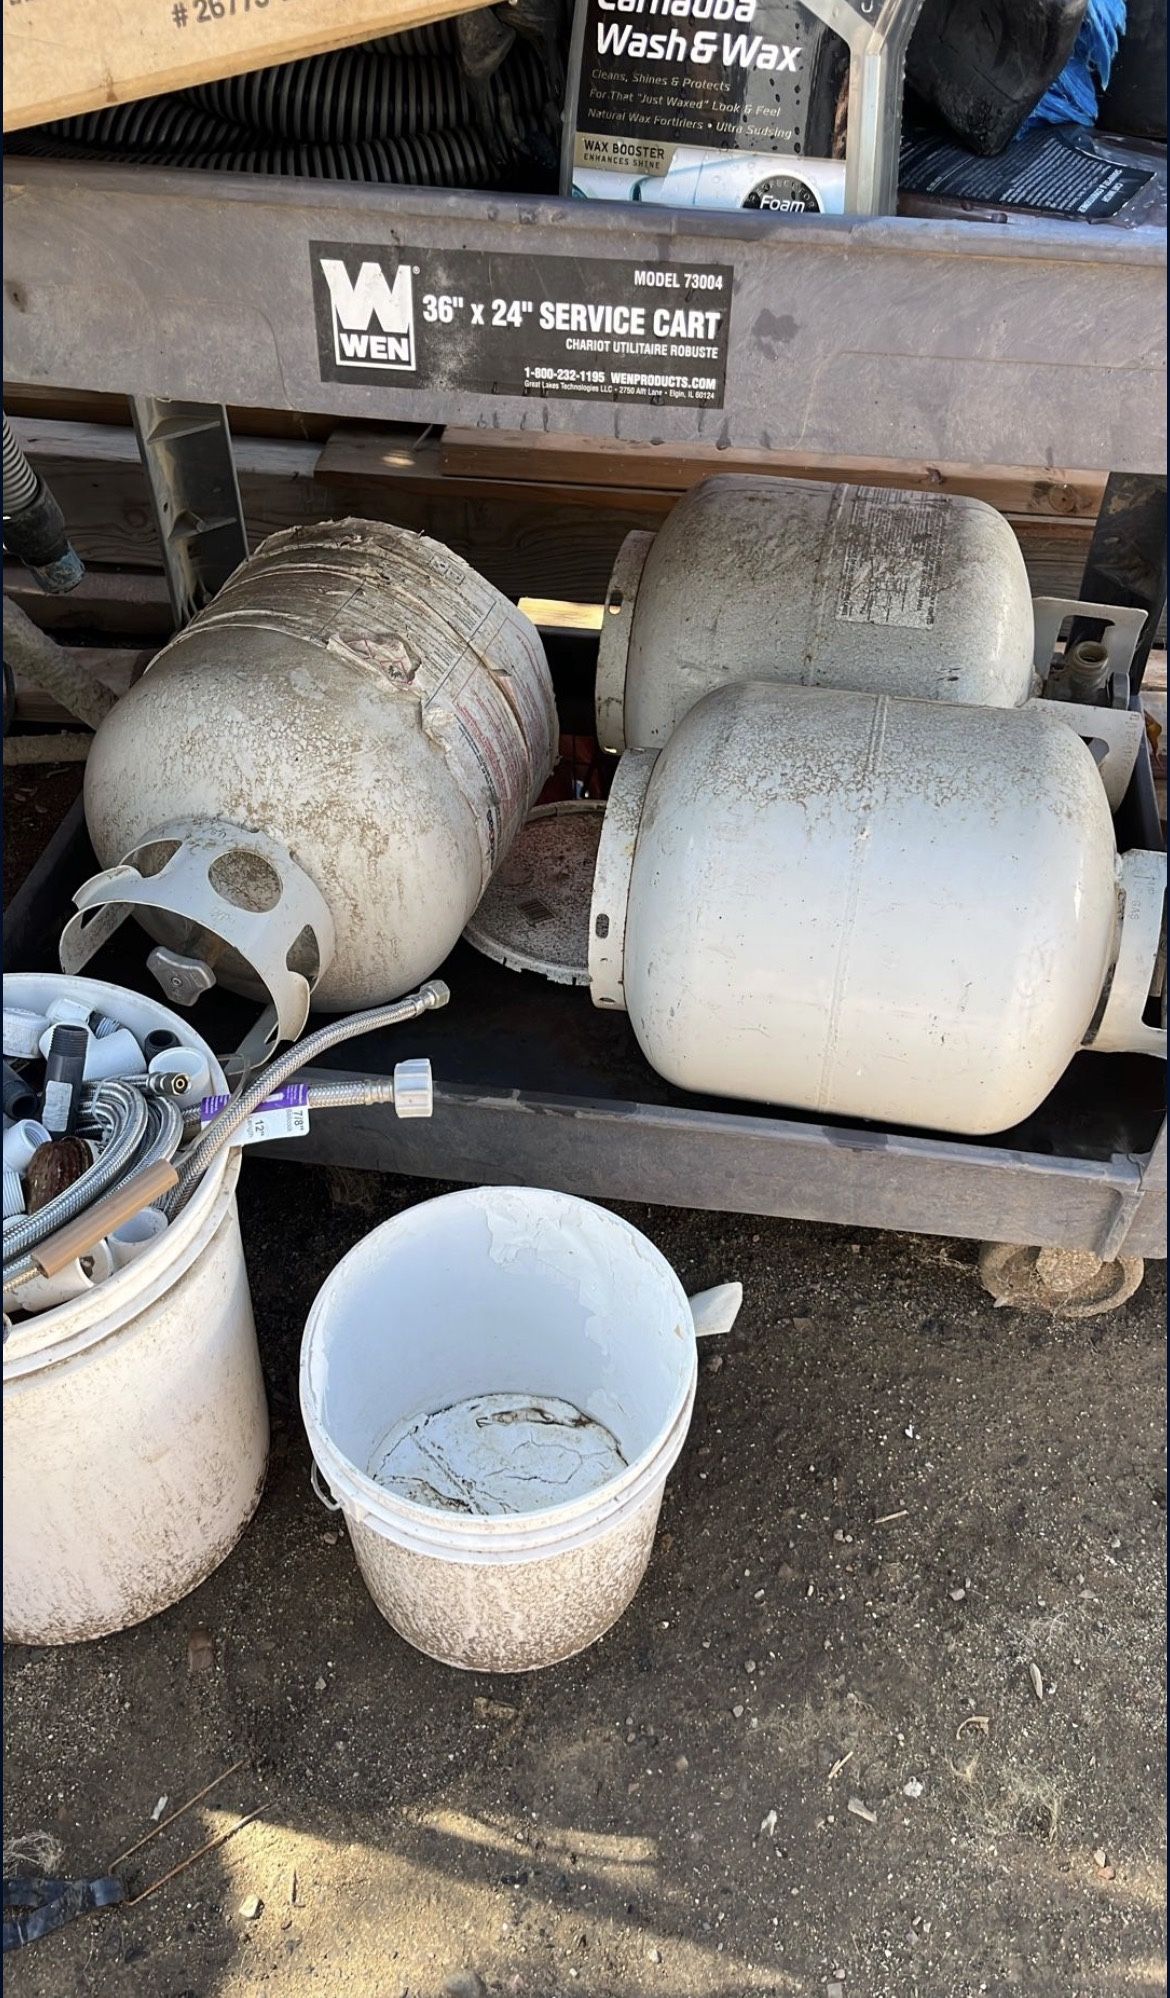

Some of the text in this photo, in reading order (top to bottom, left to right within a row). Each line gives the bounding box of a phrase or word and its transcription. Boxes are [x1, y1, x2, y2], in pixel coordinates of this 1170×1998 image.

[592, 69, 731, 92] Cleans, Shines & Protects
[590, 88, 781, 117] For That "Just Waxed" Look & Feel
[588, 108, 625, 121] Natural
[628, 112, 651, 123] Wax
[716, 121, 743, 134] Ultra
[746, 124, 792, 140] Sudsing
[584, 139, 665, 160] WAX BOOSTER
[584, 152, 661, 169] ENHANCES SHINE
[760, 195, 805, 213] Foam
[634, 270, 723, 290] MODEL 73004
[422, 294, 721, 340] 36" x 24" SERVICE CART
[339, 333, 411, 361] WEN
[565, 338, 719, 360] CHARIOT UTILITAIRE ROBUSTE
[524, 366, 717, 390] 1-800-232-1195 WENPRODUCTS.COM
[524, 380, 541, 389] Great
[542, 381, 559, 390] Lakes
[561, 382, 599, 393] Technologies
[600, 385, 613, 393] LLC
